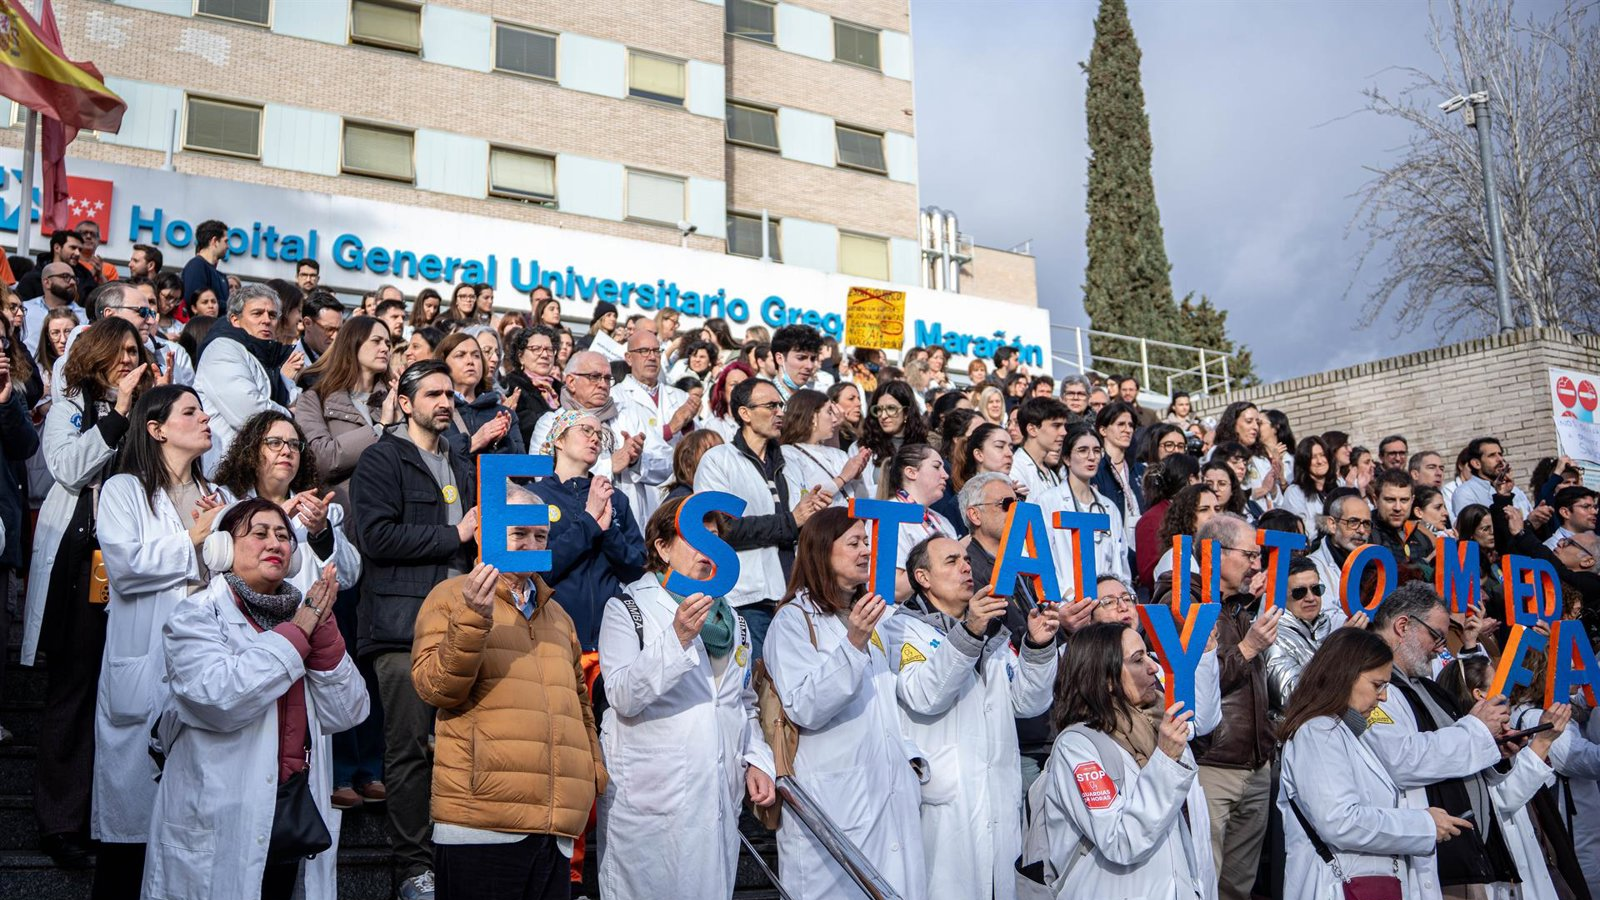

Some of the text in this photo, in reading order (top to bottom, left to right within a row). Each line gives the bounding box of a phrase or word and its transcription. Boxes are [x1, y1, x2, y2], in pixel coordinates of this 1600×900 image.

[129, 205, 318, 263] Hopital
[332, 233, 495, 288] General
[510, 257, 749, 323] Universitario
[624, 599, 644, 629] BIMBA
[1076, 769, 1105, 782] STOP
